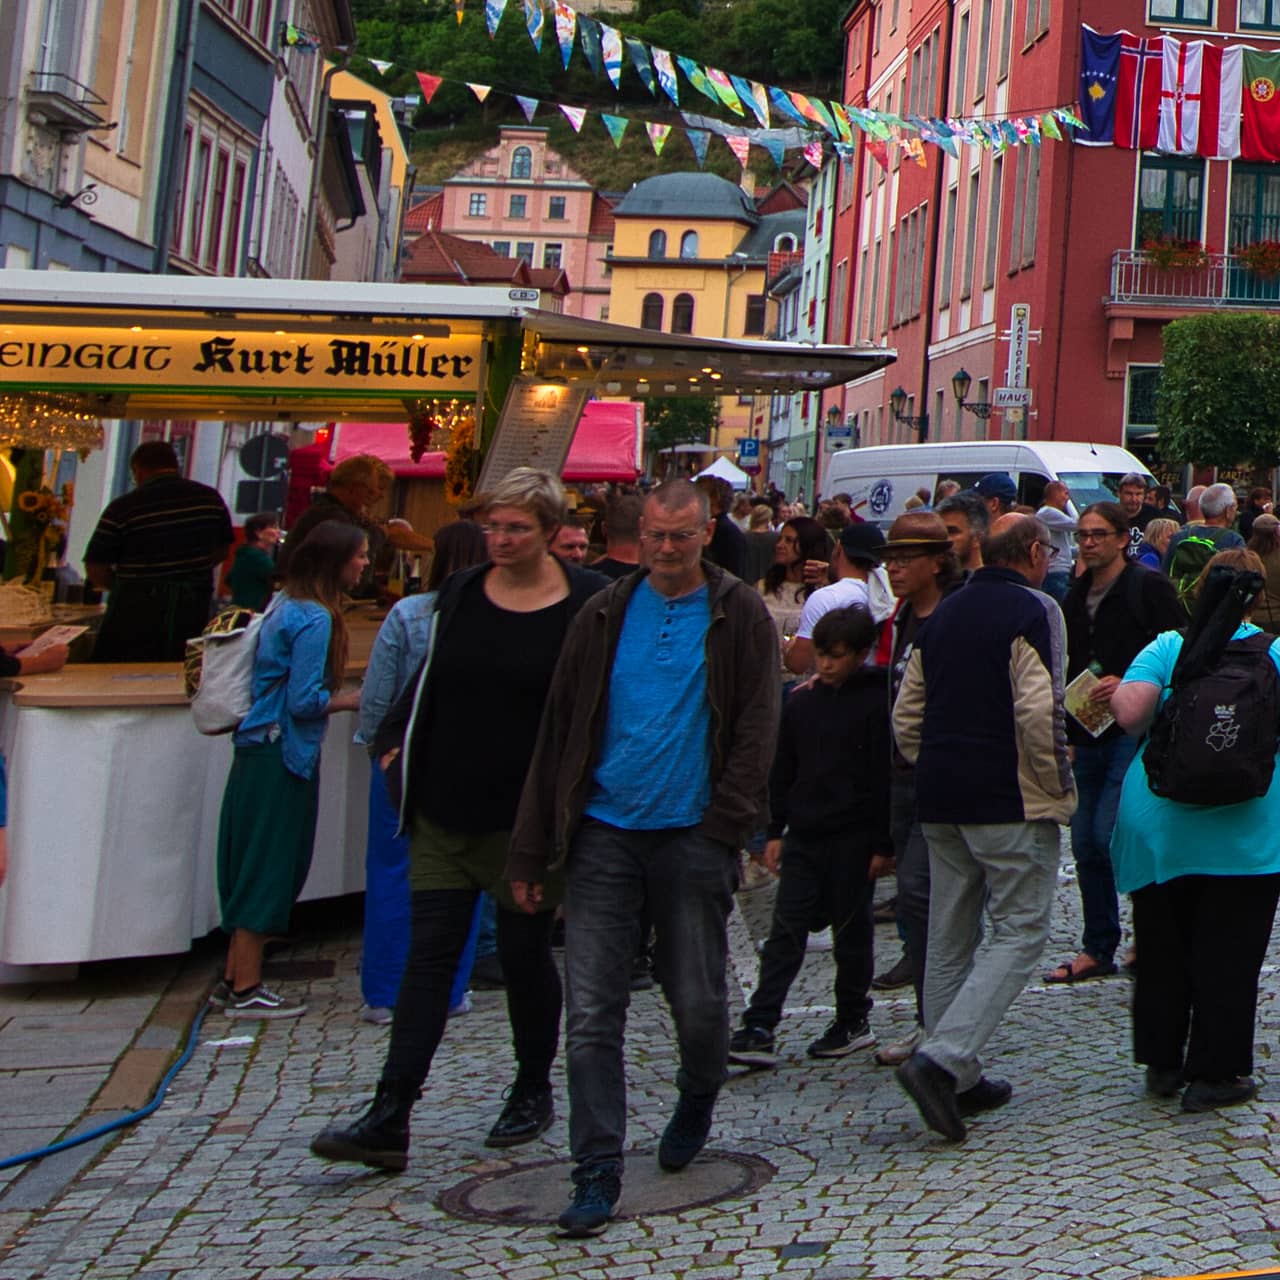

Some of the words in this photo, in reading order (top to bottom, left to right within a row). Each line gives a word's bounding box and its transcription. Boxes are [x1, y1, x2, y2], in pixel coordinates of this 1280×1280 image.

[191, 336, 314, 375] Kurt
[325, 338, 474, 379] Müller
[1014, 319, 1024, 389] KARTOFFEL
[999, 393, 1028, 402] HAUS
